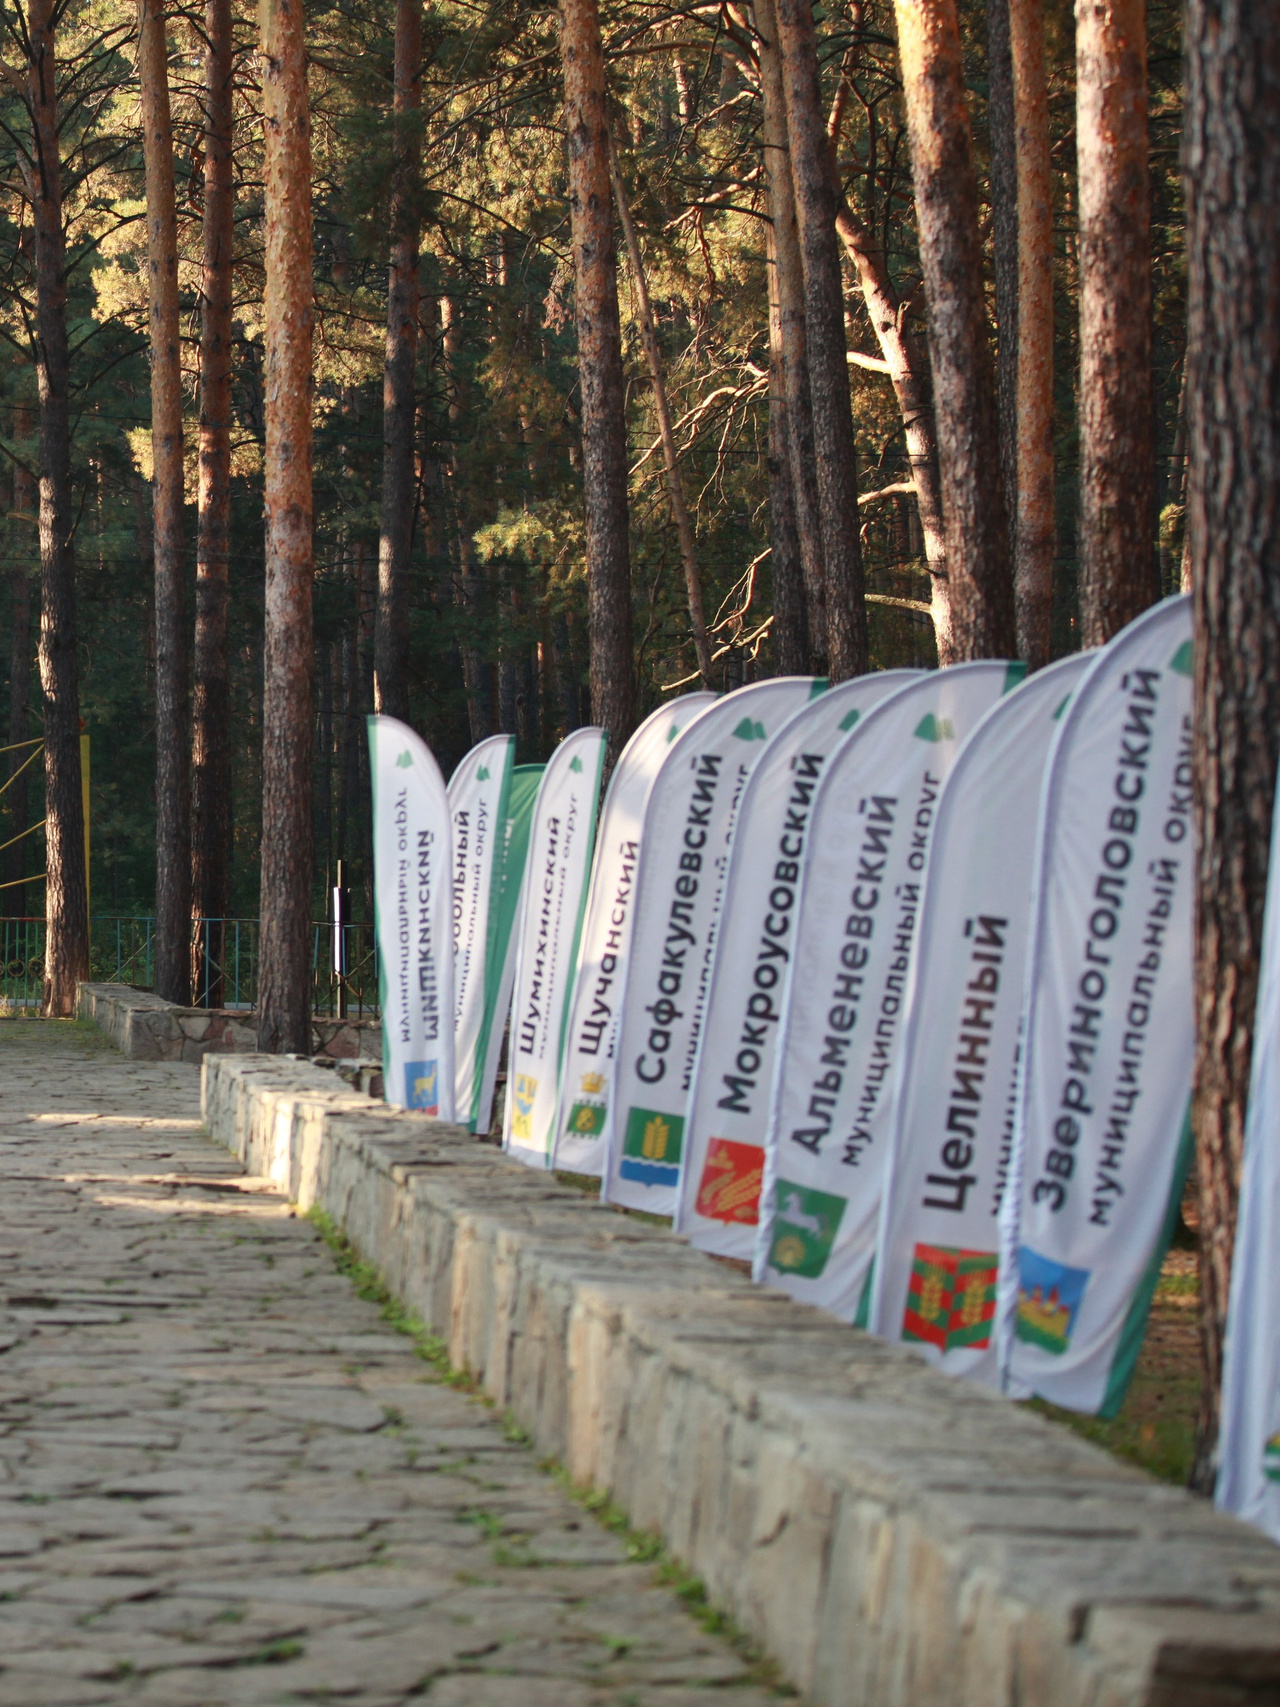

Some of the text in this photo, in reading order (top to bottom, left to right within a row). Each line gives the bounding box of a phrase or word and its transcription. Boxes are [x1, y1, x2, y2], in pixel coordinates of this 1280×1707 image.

[476, 798, 489, 857] округ
[519, 815, 562, 1056] Шумихинский
[562, 792, 578, 860] округ
[578, 839, 640, 1056] Щучанский
[635, 753, 723, 1085] Сафакулевский
[717, 752, 825, 1116] Мокроусовский
[790, 794, 900, 1157] Альменевский
[1031, 666, 1162, 1214] Звериноголовский
[840, 881, 923, 1168] муниципальный
[921, 912, 1009, 1215] Целинный
[1087, 857, 1181, 1228] муниципальный
